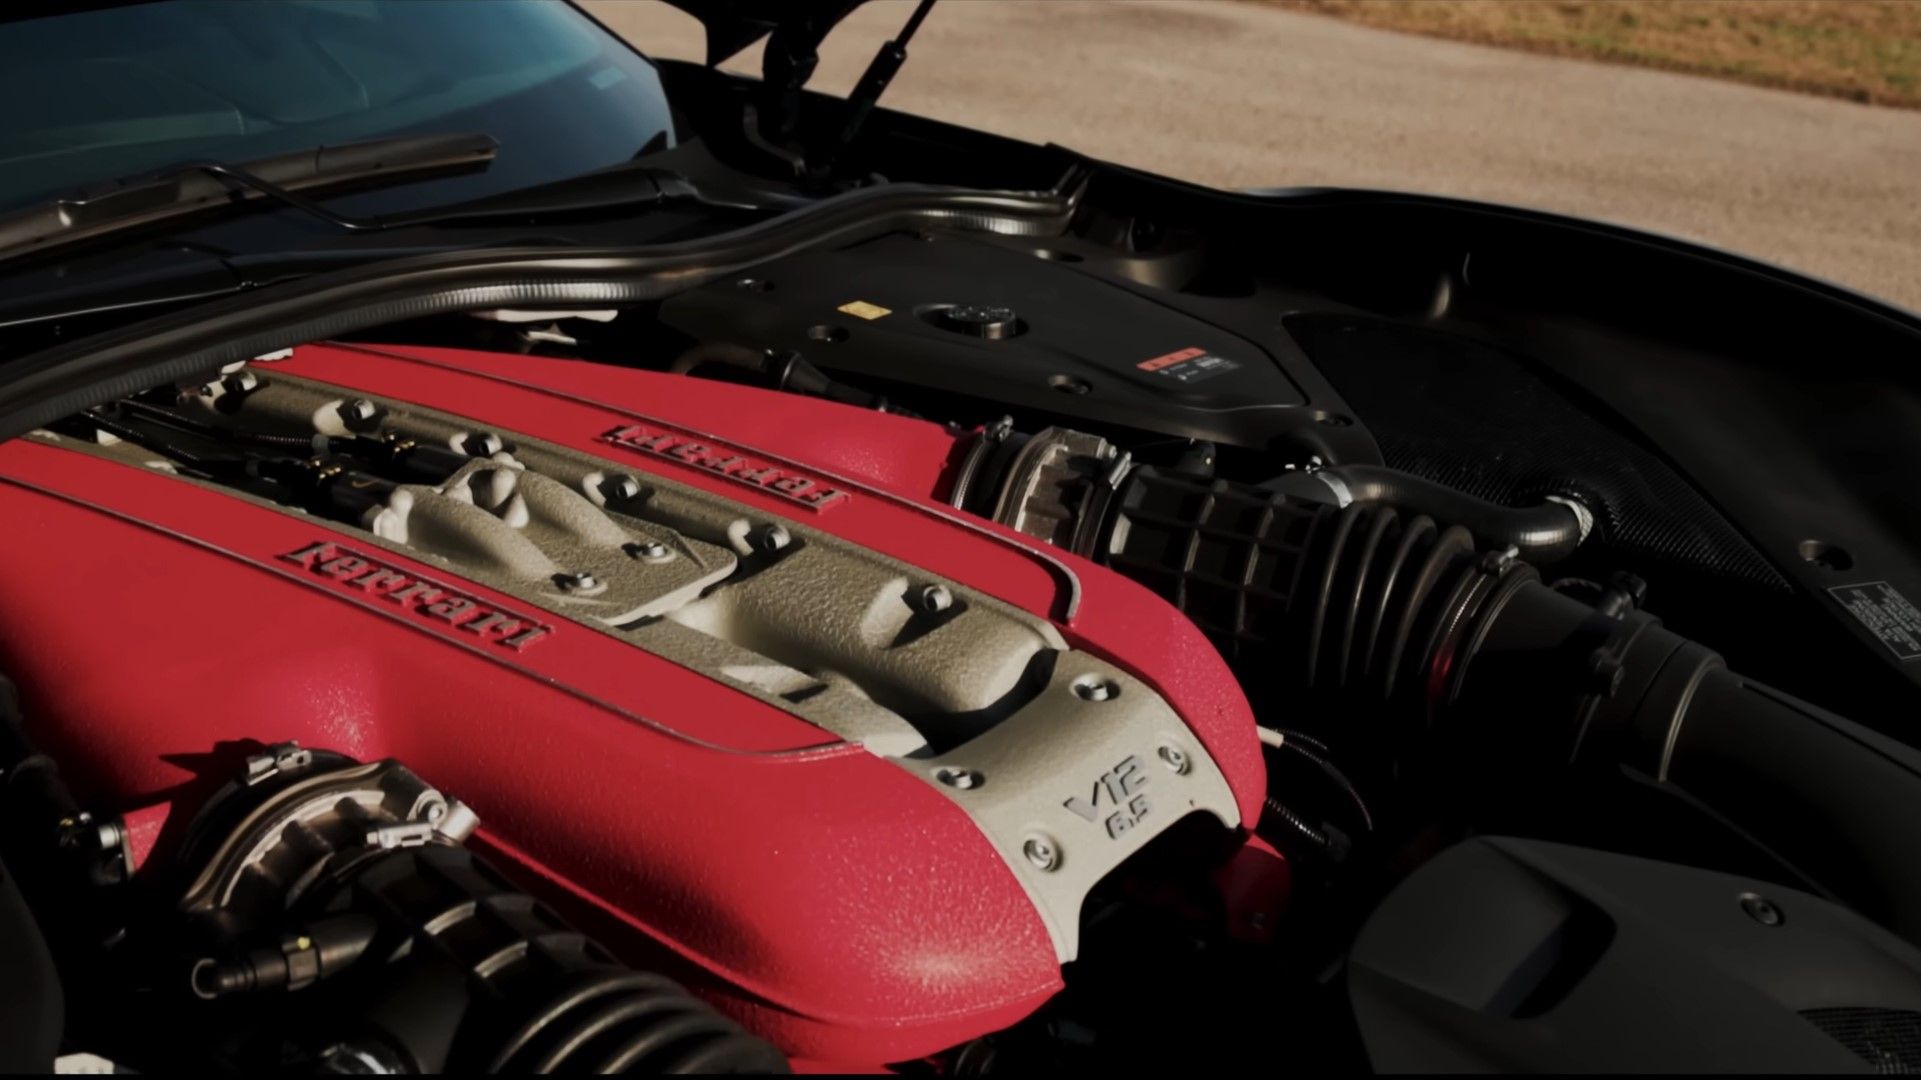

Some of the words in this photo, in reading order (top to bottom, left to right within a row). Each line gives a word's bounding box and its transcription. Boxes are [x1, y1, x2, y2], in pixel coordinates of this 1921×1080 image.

[596, 424, 851, 514] Ferrari
[276, 541, 555, 652] Ferrari
[1063, 755, 1146, 823] V12
